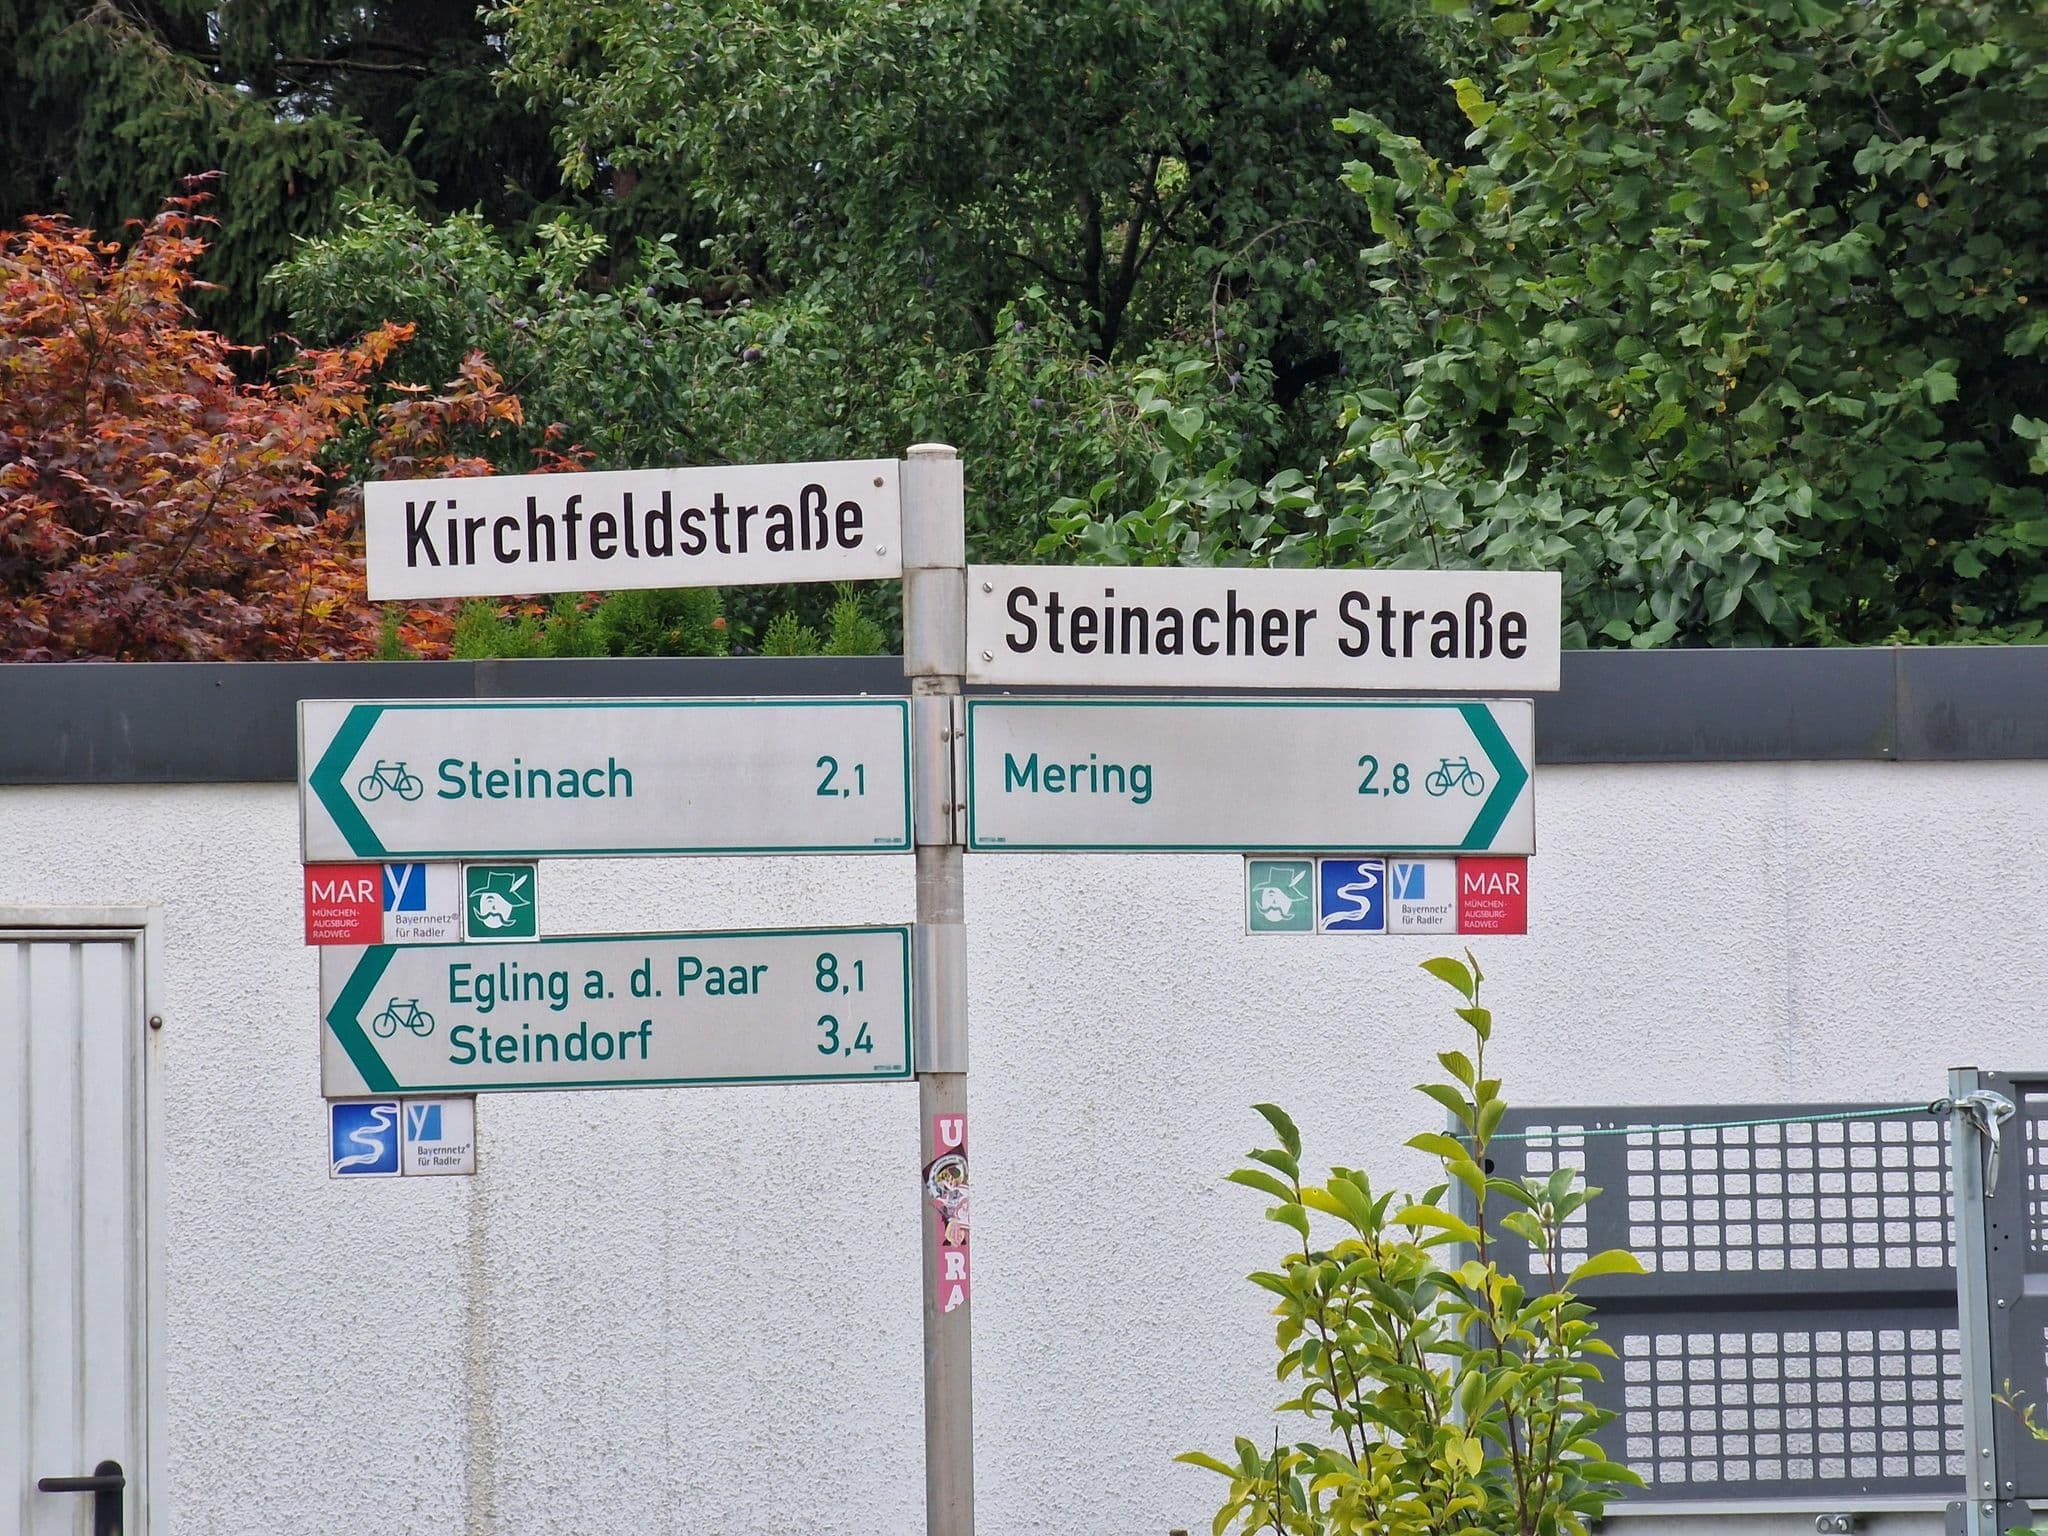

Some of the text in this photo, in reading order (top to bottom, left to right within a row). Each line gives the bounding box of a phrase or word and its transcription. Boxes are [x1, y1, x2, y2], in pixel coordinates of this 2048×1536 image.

[405, 483, 864, 568] Kirchfeldstraße
[1005, 586, 1528, 660] Steinacher Straße
[437, 755, 866, 800] Steinach 2,1
[1004, 752, 1410, 805] Mering 2,8
[311, 879, 375, 904] MAR
[1464, 872, 1521, 896] MAR
[1402, 915, 1444, 925] für Radler
[1464, 920, 1499, 929] RADWEG
[313, 930, 351, 938] RADWEG
[395, 928, 446, 938] für Radler
[449, 954, 865, 1014] Egling a. d. Paar 8,1
[448, 1014, 875, 1066] Steindorf 3,4
[418, 1156, 461, 1167] für Radler
